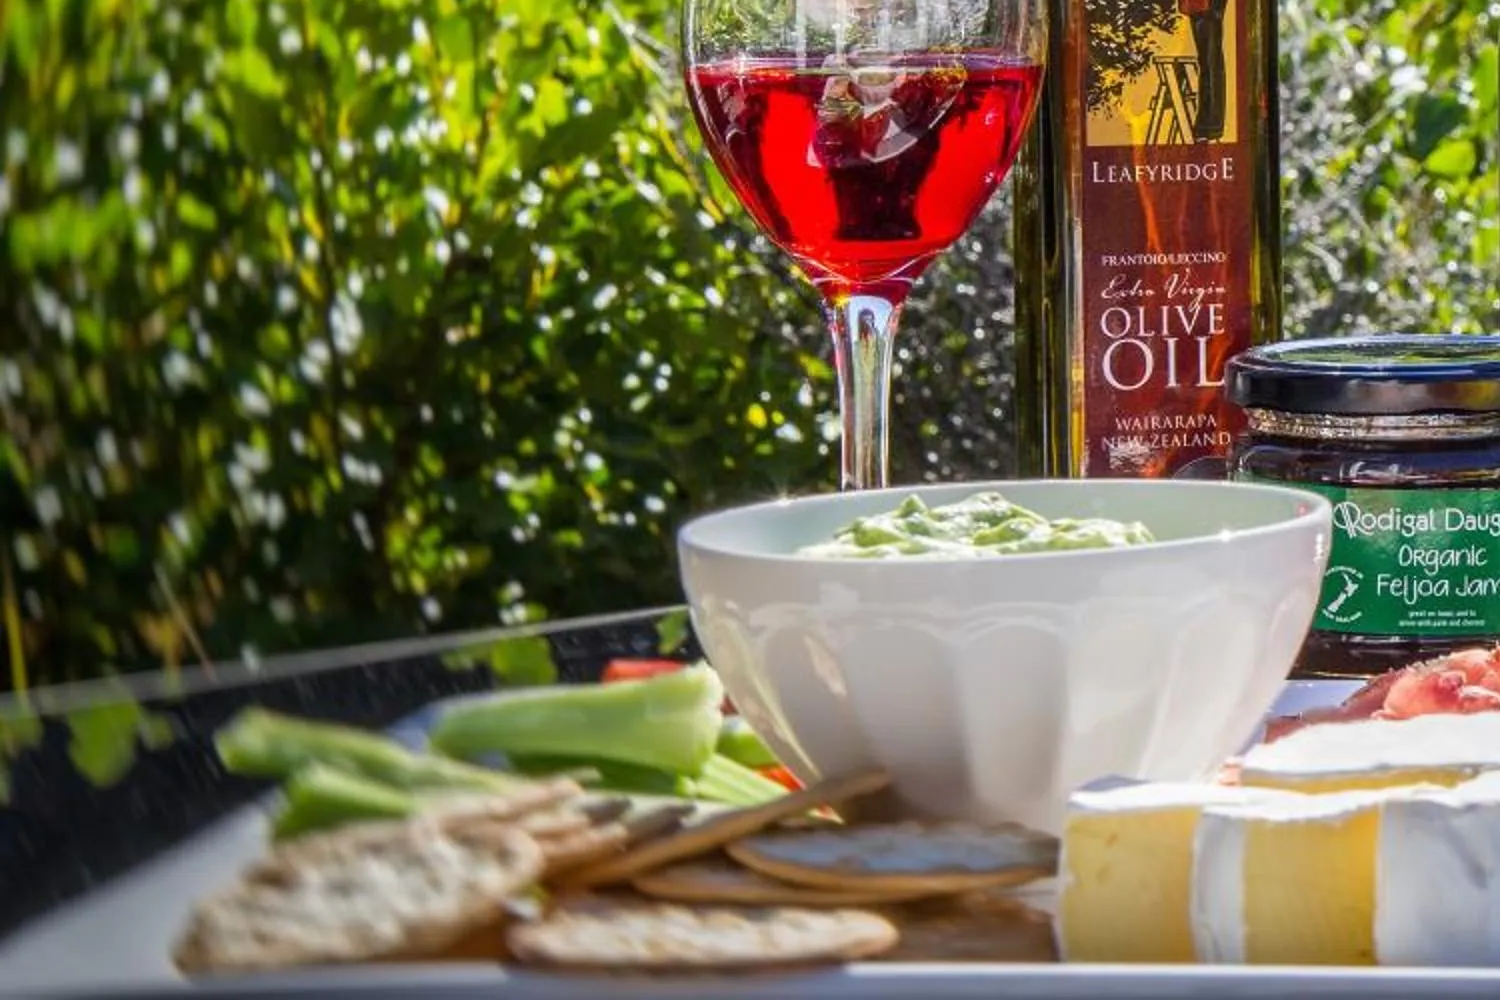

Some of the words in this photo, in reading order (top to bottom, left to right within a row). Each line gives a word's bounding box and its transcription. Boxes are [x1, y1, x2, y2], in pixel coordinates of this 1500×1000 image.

[1100, 303, 1226, 338] OLIVE
[1102, 335, 1225, 391] OIL
[1151, 431, 1231, 449] ZEALAND
